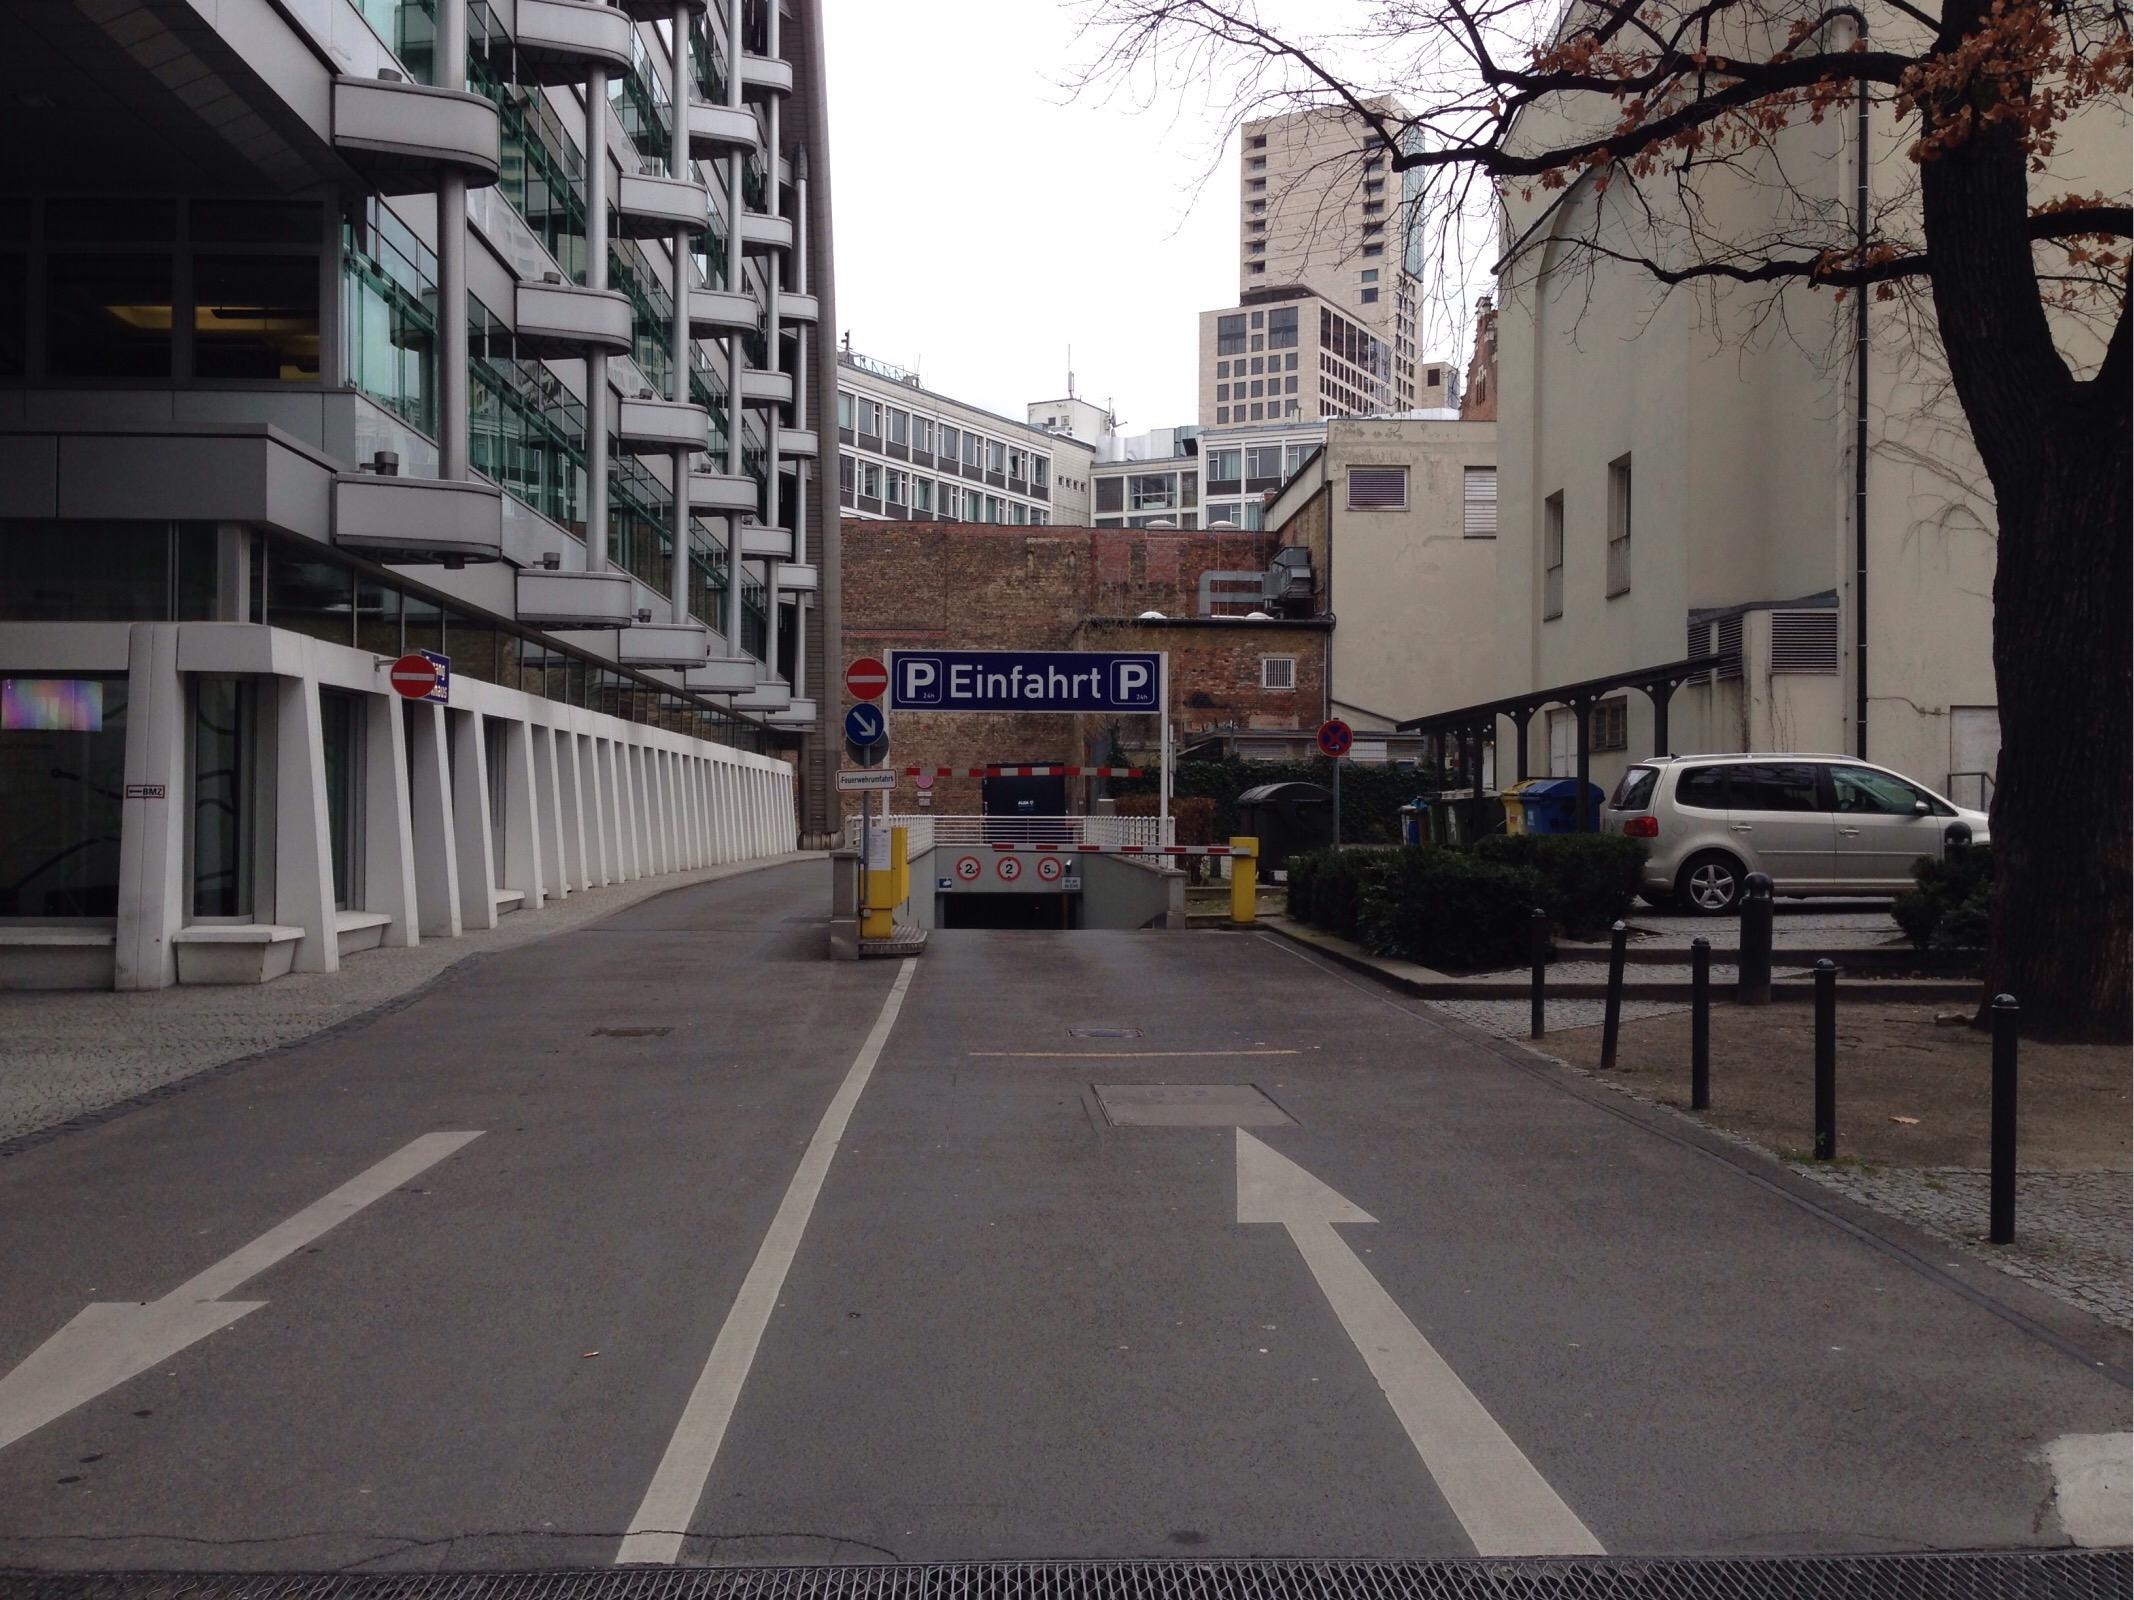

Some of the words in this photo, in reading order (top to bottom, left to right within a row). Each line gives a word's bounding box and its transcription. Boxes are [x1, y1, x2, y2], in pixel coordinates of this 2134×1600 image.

[907, 662, 935, 698] P
[951, 665, 1101, 699] Einfahrt
[1121, 664, 1148, 700] P
[1136, 693, 1148, 701] 24h
[1005, 863, 1013, 874] 2
